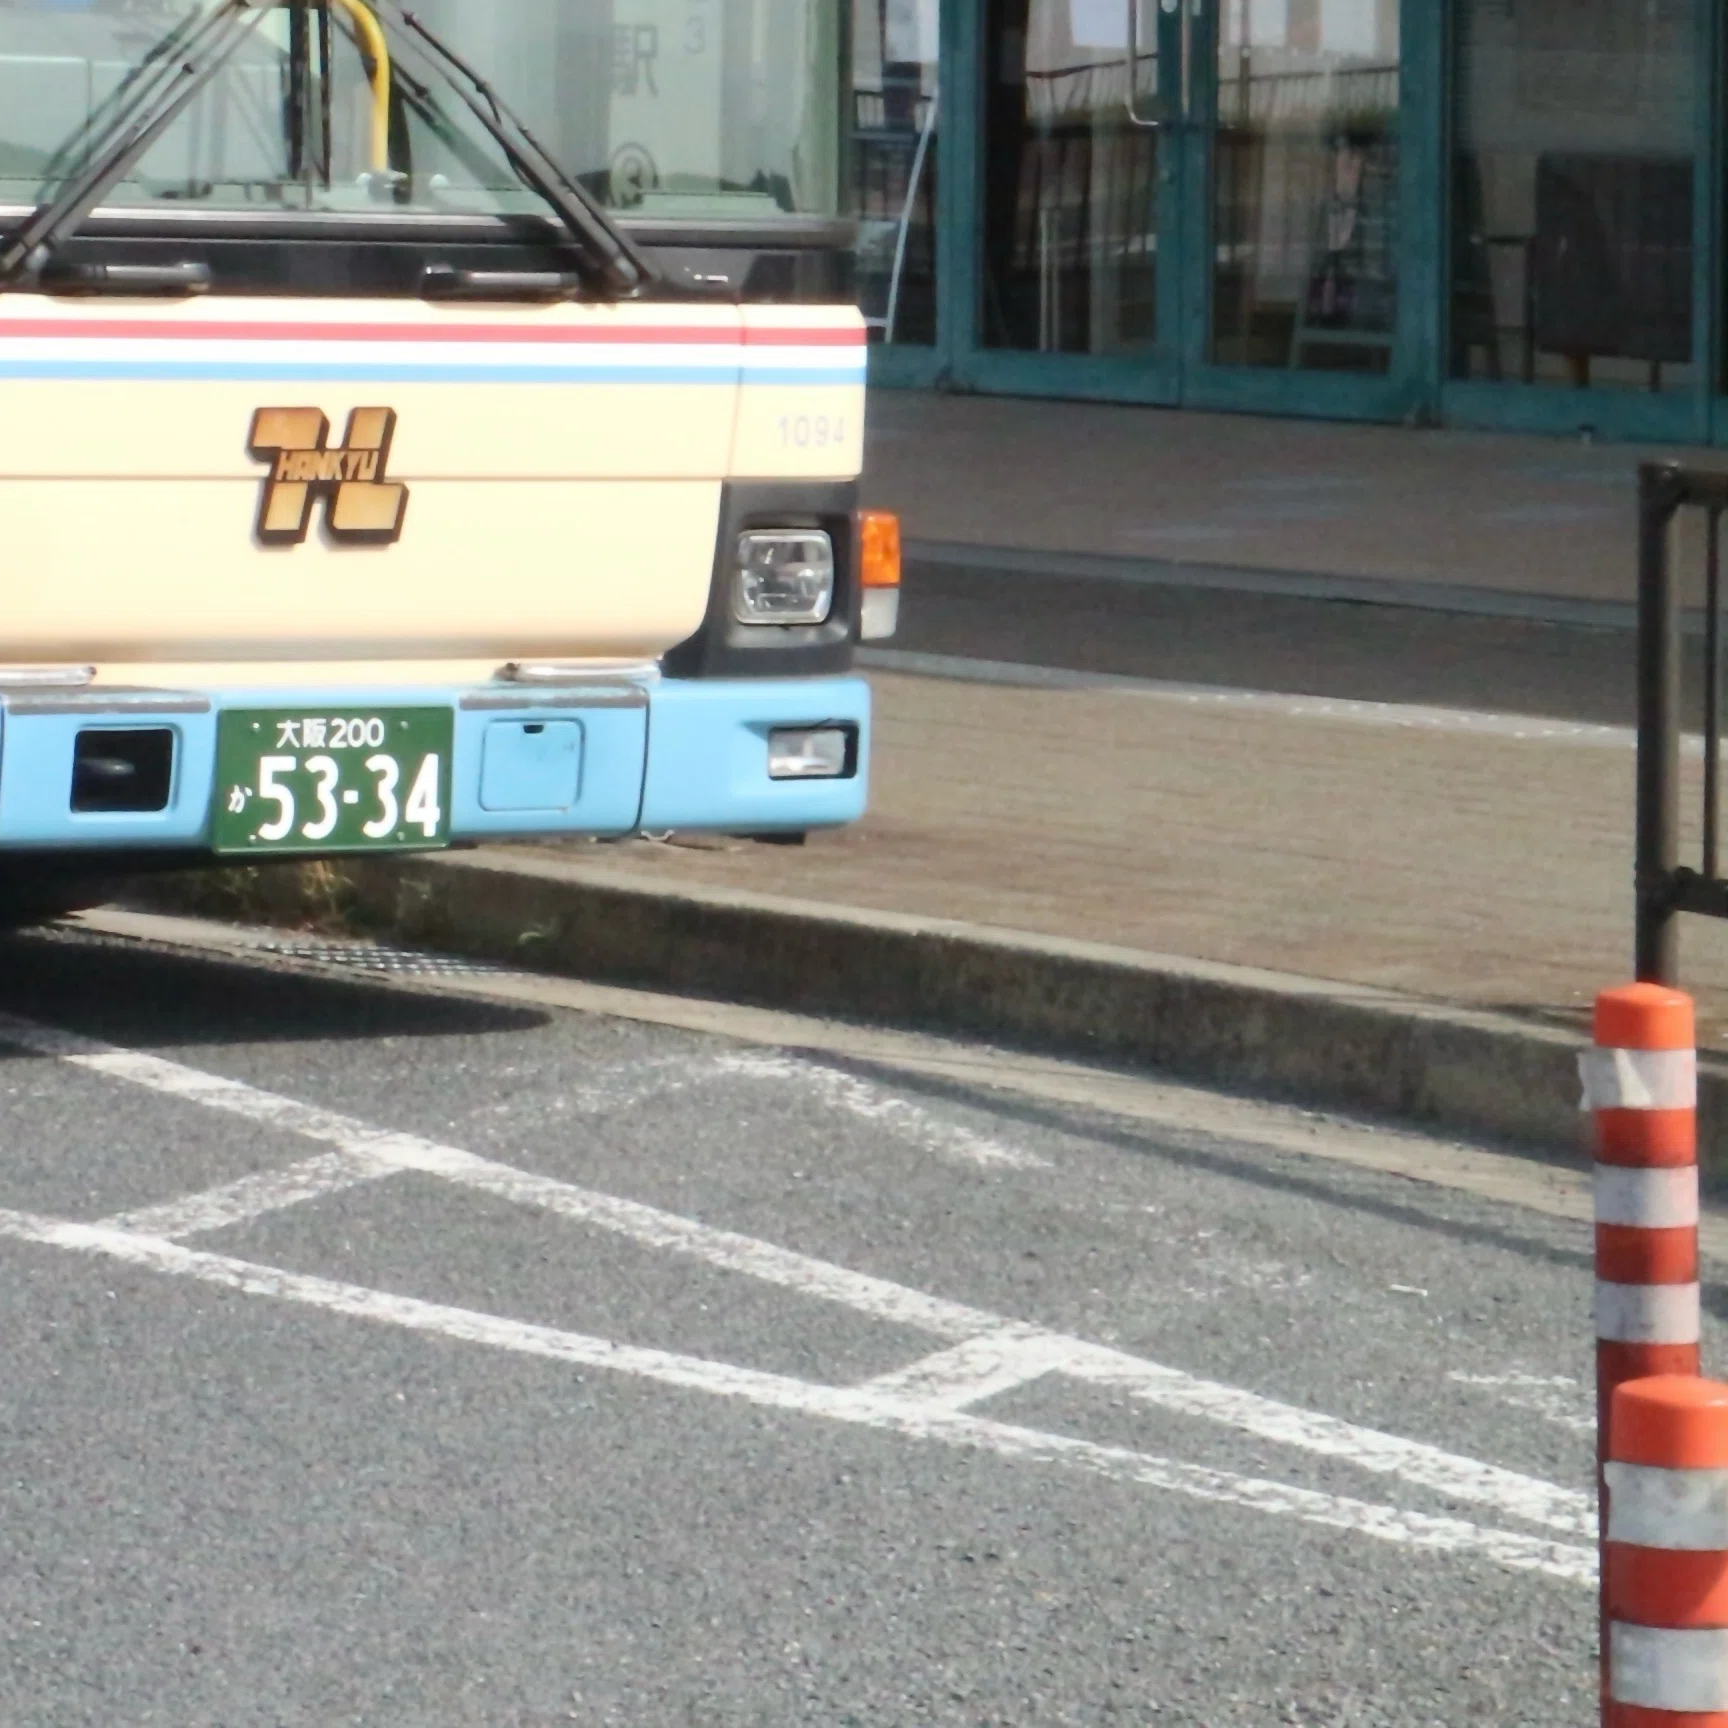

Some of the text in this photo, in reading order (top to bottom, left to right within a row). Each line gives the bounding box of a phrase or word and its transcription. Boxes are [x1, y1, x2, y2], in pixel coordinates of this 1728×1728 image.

[777, 415, 845, 448] 1094
[276, 450, 379, 481] HANKYU
[258, 753, 441, 840] 53-34
